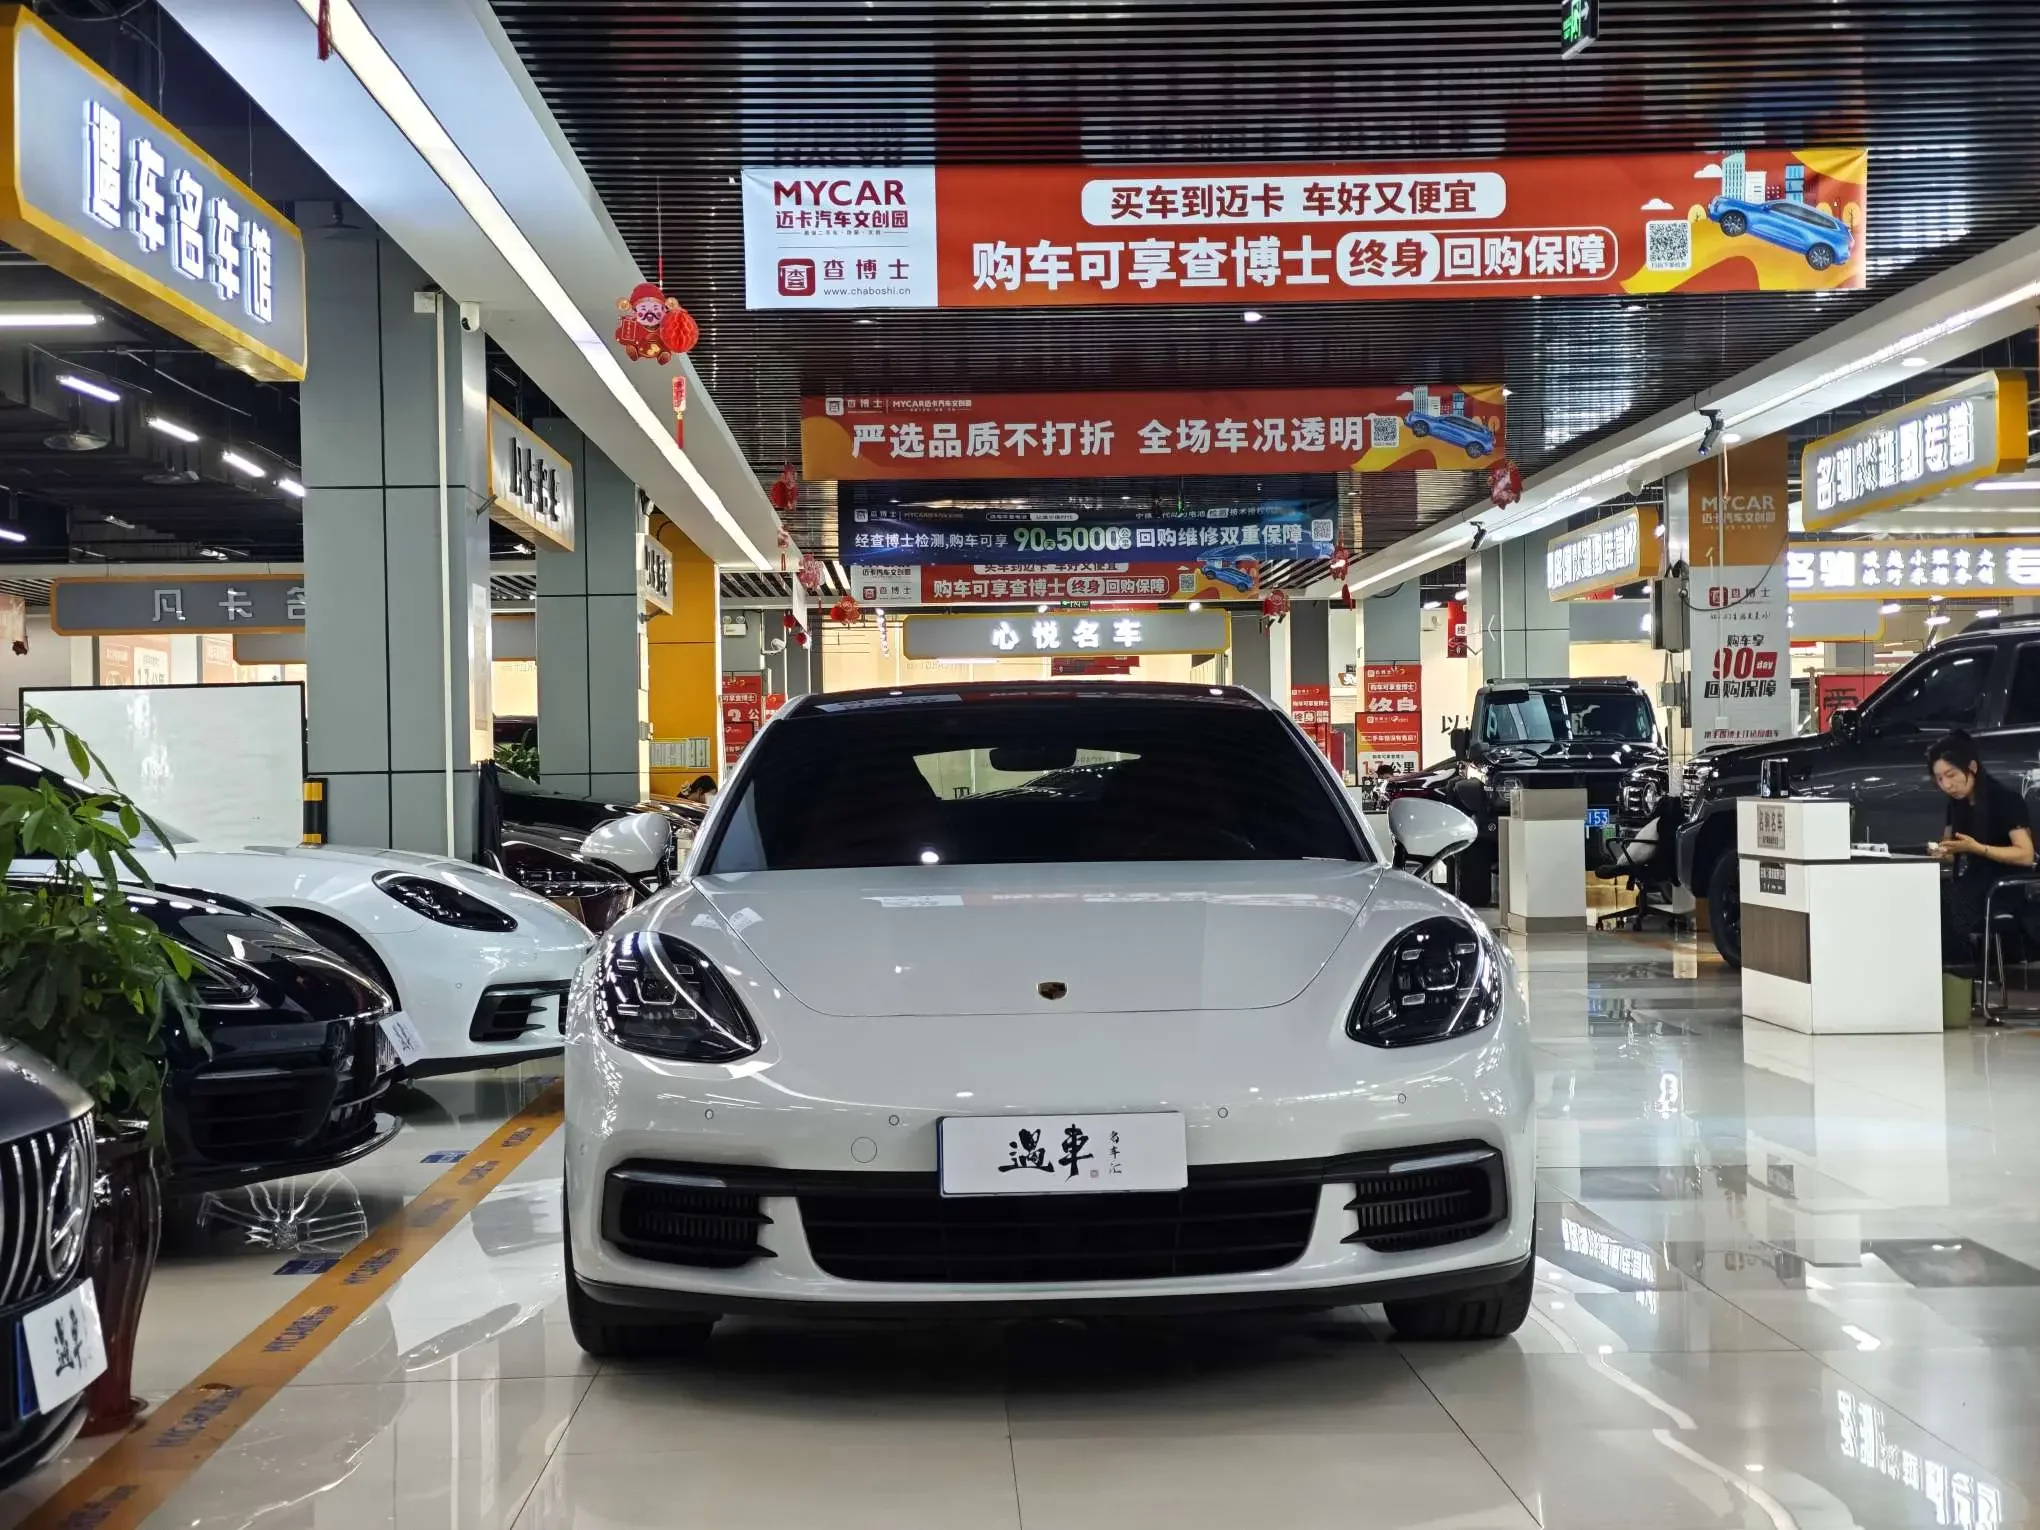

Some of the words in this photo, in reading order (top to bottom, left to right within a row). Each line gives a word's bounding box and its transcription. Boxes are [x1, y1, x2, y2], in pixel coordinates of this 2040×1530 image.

[773, 180, 906, 206] MYCAR
[1110, 183, 1284, 219] 买车到迈卡
[1303, 179, 1476, 216] 车好又便宜
[776, 210, 908, 229] 迈卡汽车文创园
[824, 259, 909, 281] 查博士
[972, 236, 1332, 291] 购车可享查博士
[1348, 236, 1429, 278] 终身
[1444, 234, 1606, 277] 回购保障
[824, 286, 911, 296] www.chaboshi.cn
[851, 419, 1115, 458] 严选品质不打折
[1136, 415, 1364, 455] 全场车况透明
[1136, 524, 1303, 547] 回购维修双重保障
[933, 579, 1066, 598] 购车可享查博士
[1106, 578, 1166, 594] 回购保障
[992, 620, 1142, 650] 心悦名车
[1727, 634, 1765, 647] 购车享
